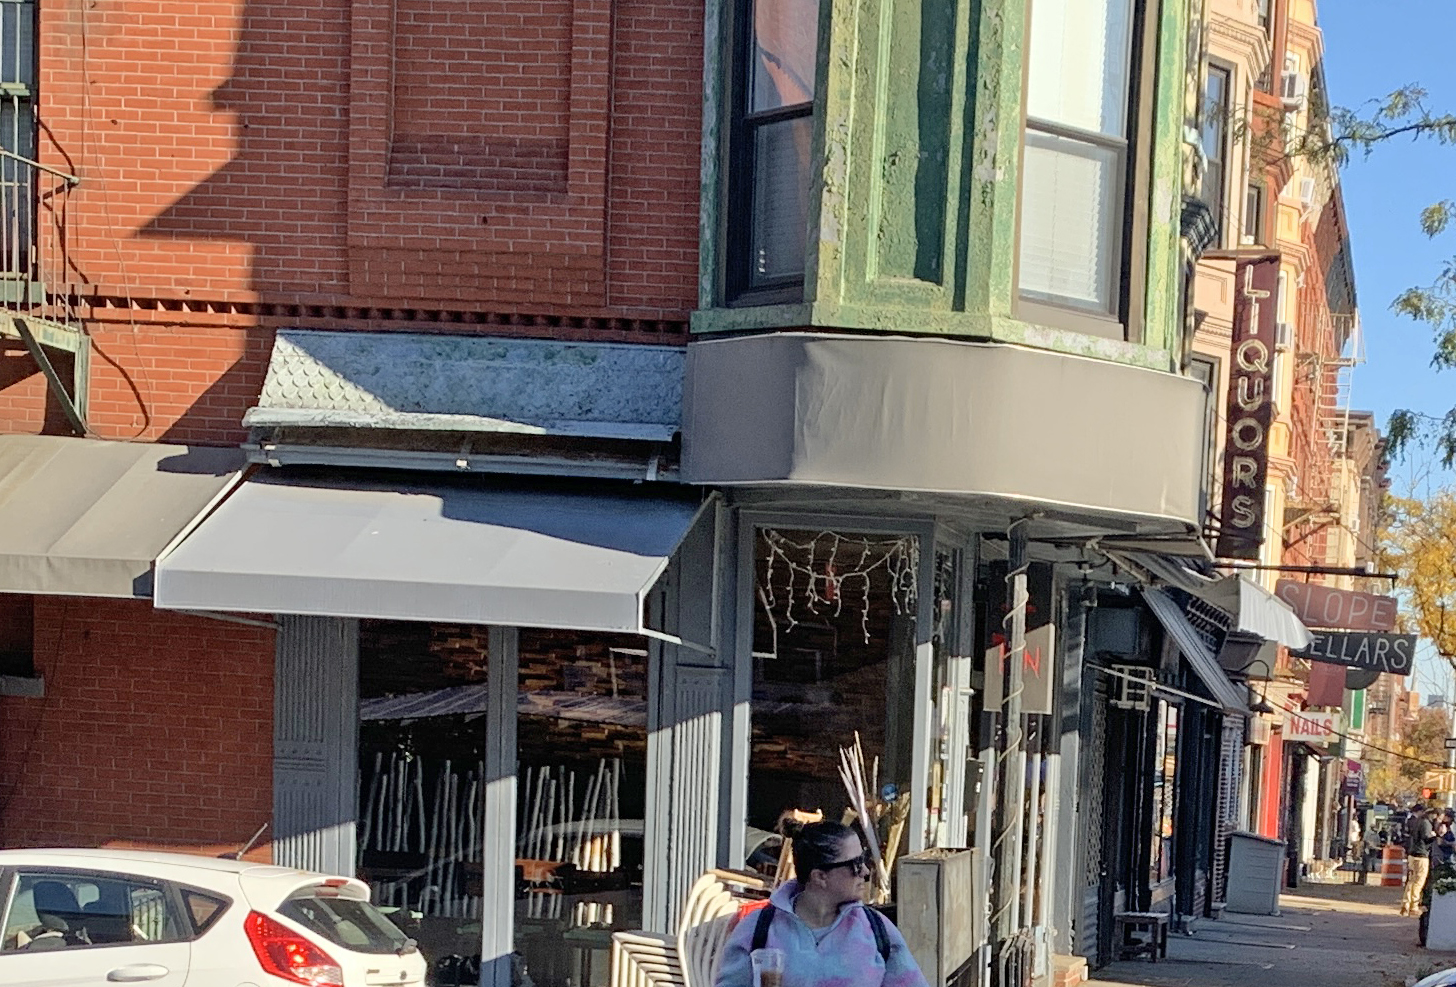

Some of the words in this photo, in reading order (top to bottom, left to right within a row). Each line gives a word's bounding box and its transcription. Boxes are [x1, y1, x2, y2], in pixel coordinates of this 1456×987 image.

[1231, 264, 1271, 528] LIQUORS
[1282, 584, 1392, 627] SLOPE
[1297, 634, 1409, 674] ELLARS
[1290, 718, 1333, 737] NAILS
